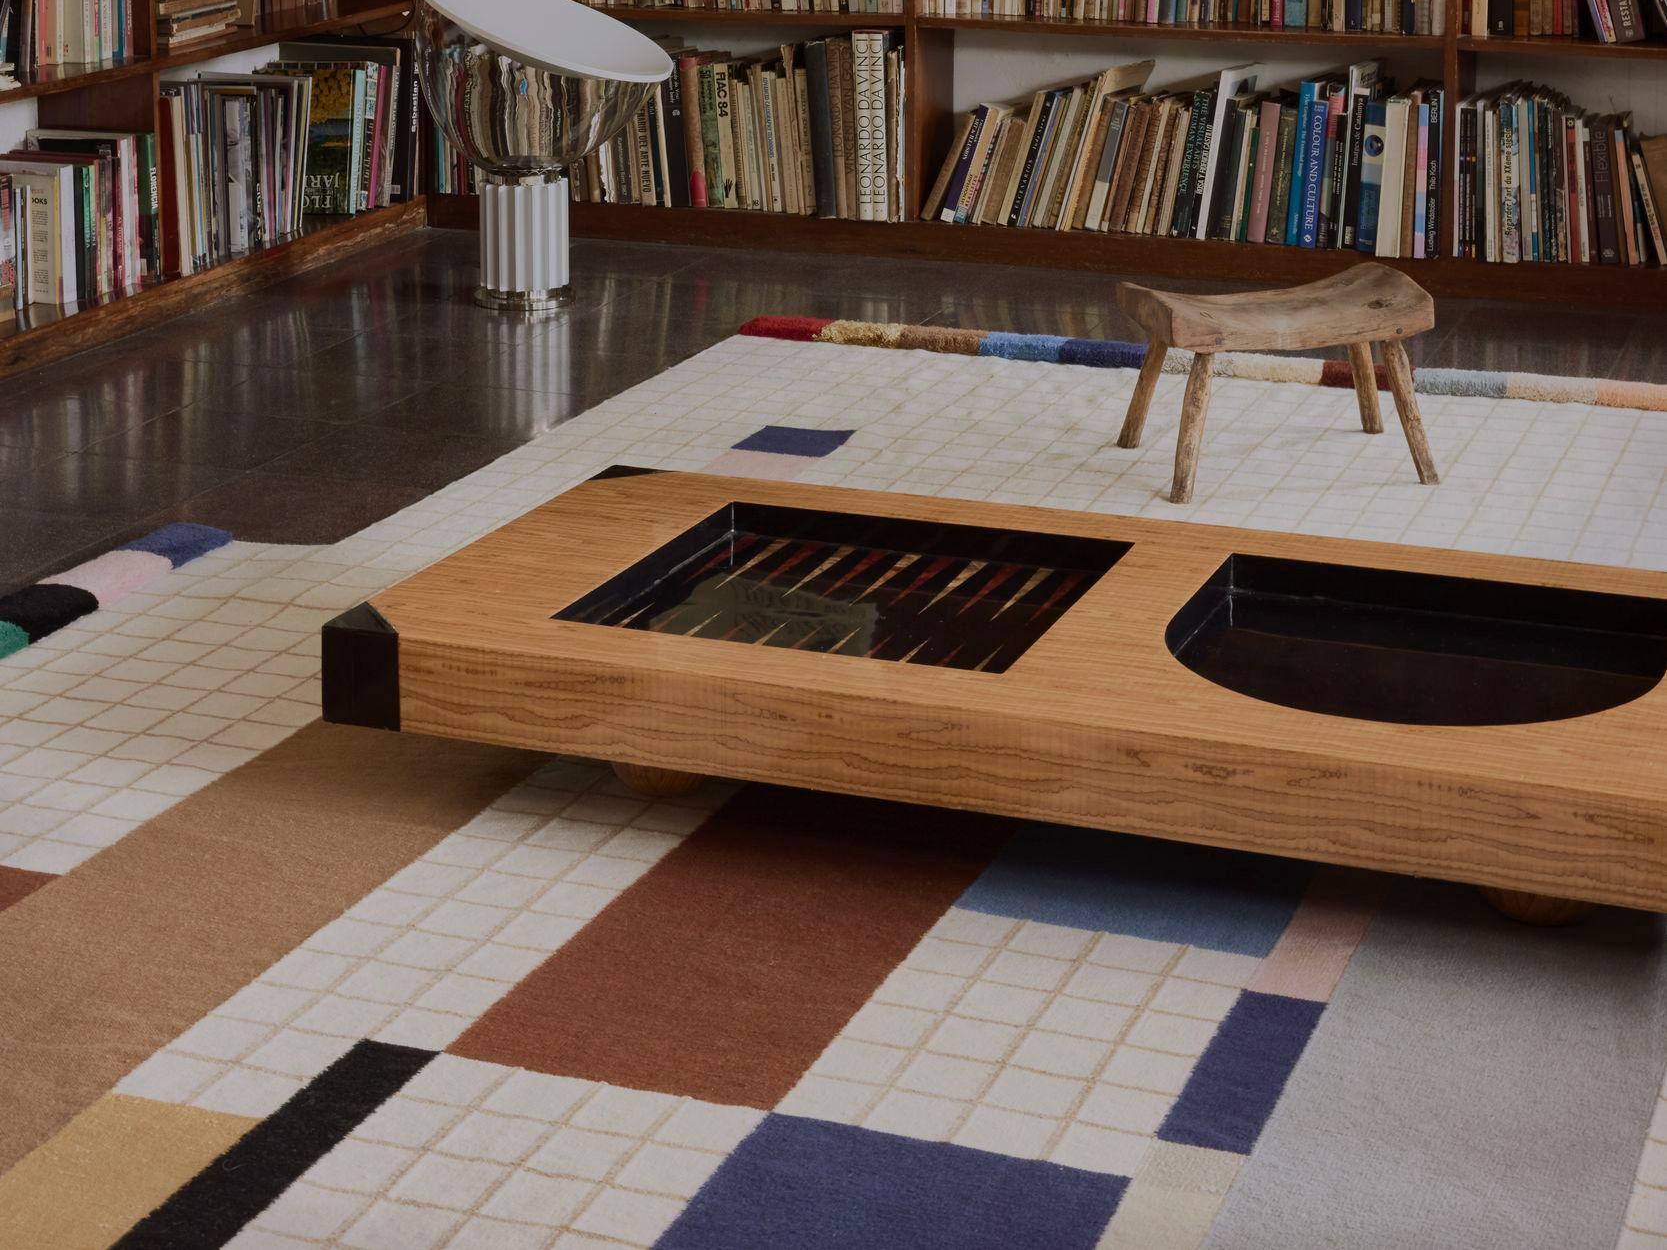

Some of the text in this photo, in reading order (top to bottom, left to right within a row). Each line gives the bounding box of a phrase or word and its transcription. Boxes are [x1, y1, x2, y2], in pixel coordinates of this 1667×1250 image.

[715, 71, 729, 117] FIAC 84
[761, 76, 770, 100] ADVANCED
[842, 88, 853, 112] VAN
[763, 100, 773, 130] CALLIGRAPHY
[856, 38, 871, 203] LEONARDO DA VINCI
[872, 38, 884, 203] LEONARDO DA VINCI
[1429, 98, 1439, 123] BERLIN
[638, 134, 647, 147] DEL
[766, 131, 775, 158] TECHNIQUES
[1177, 96, 1202, 194] AS HUMAN EXPERIENCE
[1191, 97, 1210, 169] THE VISUAL ARTS
[1351, 97, 1364, 165] Imatges de Catalunya
[639, 149, 649, 167] ARTE
[843, 120, 856, 174] VINCENT
[1593, 131, 1608, 182] Flexible
[640, 169, 651, 192] NUEVO
[1304, 114, 1322, 230] COLOUR AND CULTURE
[1428, 176, 1436, 190] Thilo
[1504, 176, 1511, 184] du
[150, 167, 158, 210] FLORENCIA
[1504, 203, 1515, 235] Regarder
[1426, 230, 1435, 251] Ludwig
